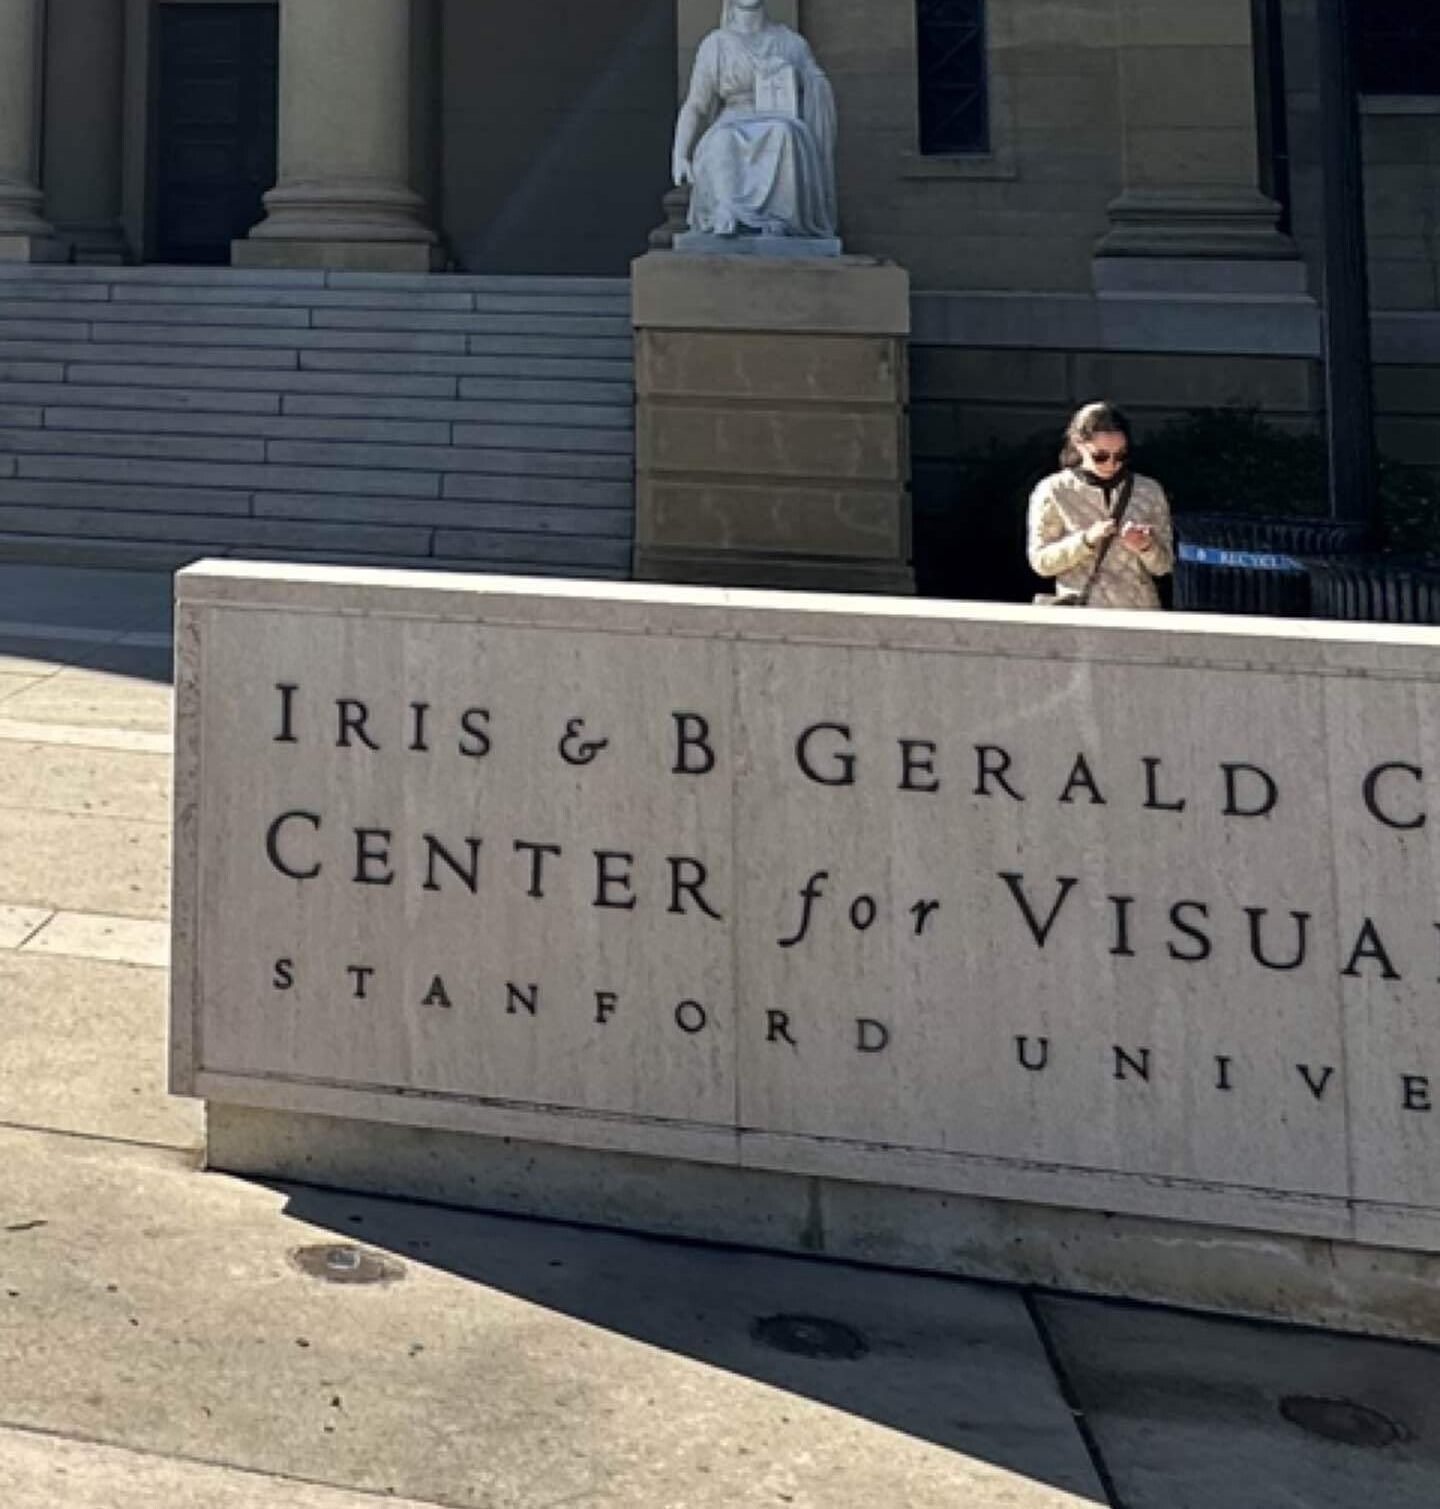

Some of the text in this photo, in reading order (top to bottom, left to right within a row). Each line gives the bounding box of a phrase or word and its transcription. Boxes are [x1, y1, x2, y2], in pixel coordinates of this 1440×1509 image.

[1219, 550, 1300, 571] RECYCLIN
[272, 681, 492, 760] IRIS
[557, 717, 610, 767] &
[670, 711, 721, 777] B
[793, 720, 1280, 819] GERALD
[265, 809, 724, 922] CENTER
[775, 869, 941, 950] for
[272, 957, 892, 1055] STANFORD
